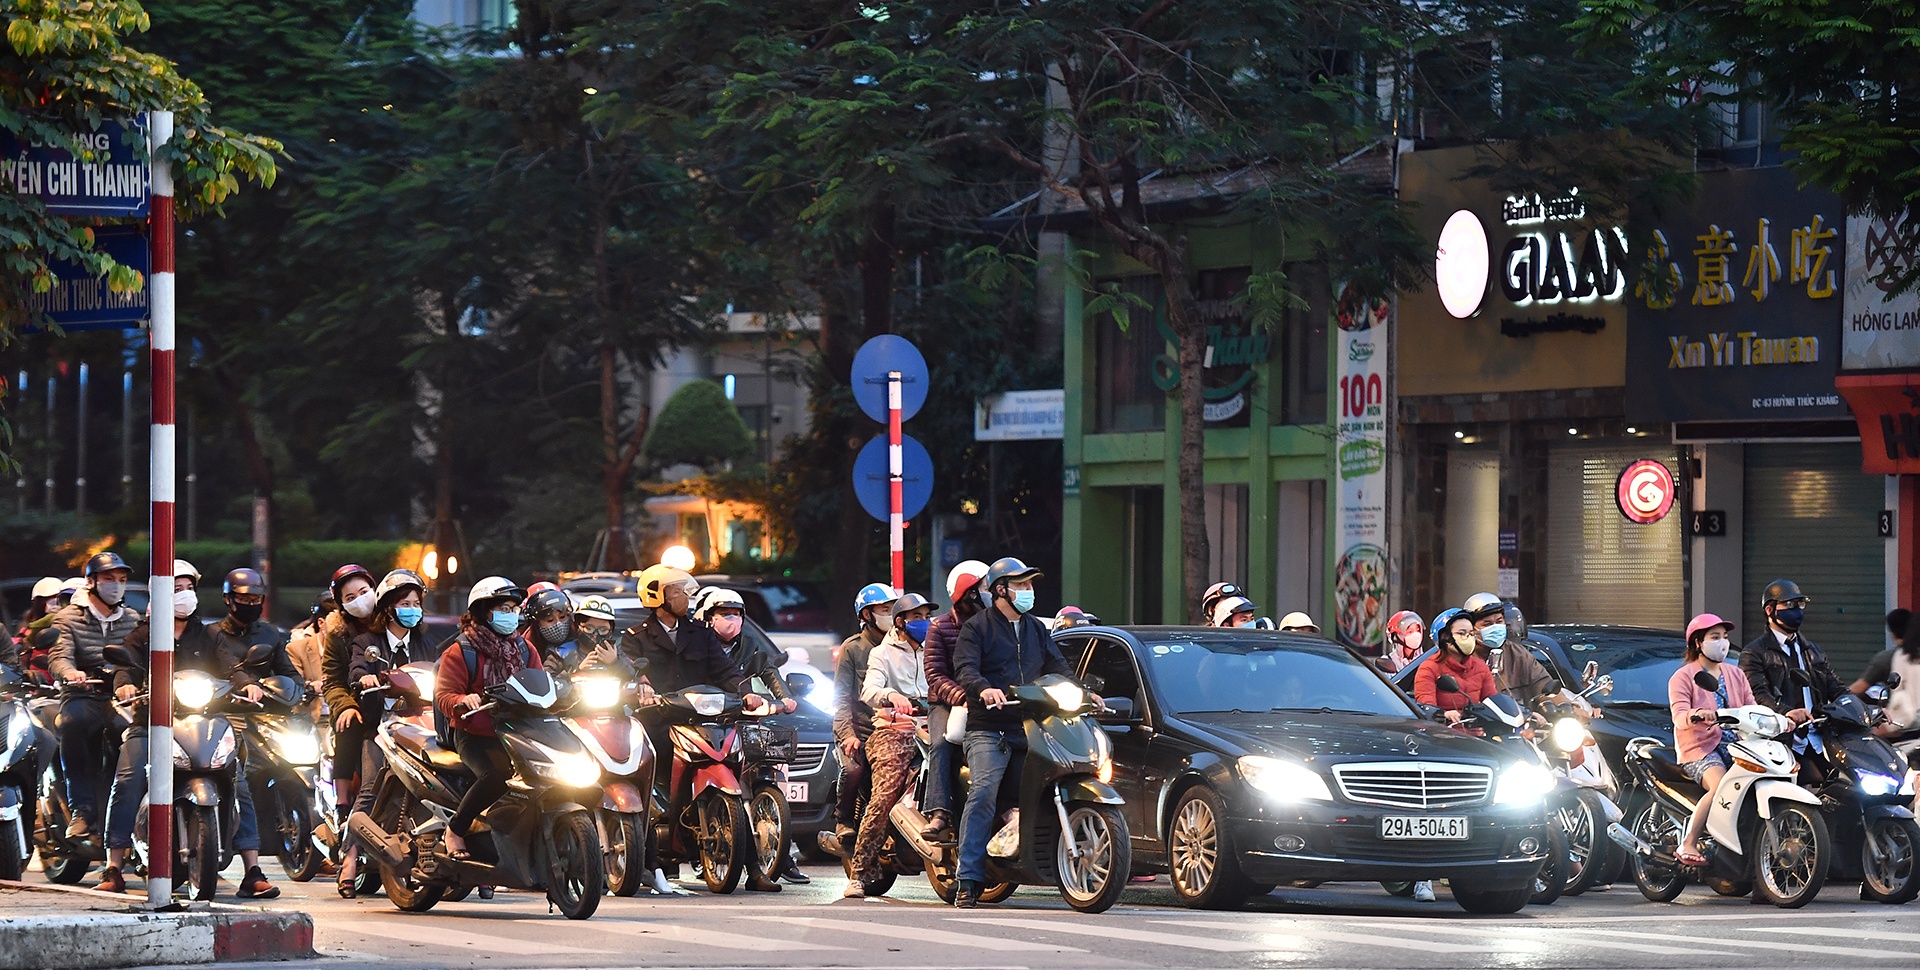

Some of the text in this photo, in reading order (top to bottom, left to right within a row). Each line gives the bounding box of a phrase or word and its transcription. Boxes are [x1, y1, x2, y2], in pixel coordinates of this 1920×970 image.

[47, 157, 77, 196] CHÍ
[83, 162, 142, 198] THANH
[1635, 214, 1839, 309] 心意小吃
[1853, 306, 1891, 331] HỒNG
[1667, 331, 1819, 368] Xin Yi Taiwan
[1340, 373, 1382, 418] 100
[1384, 818, 1464, 837] 29A-504.61
